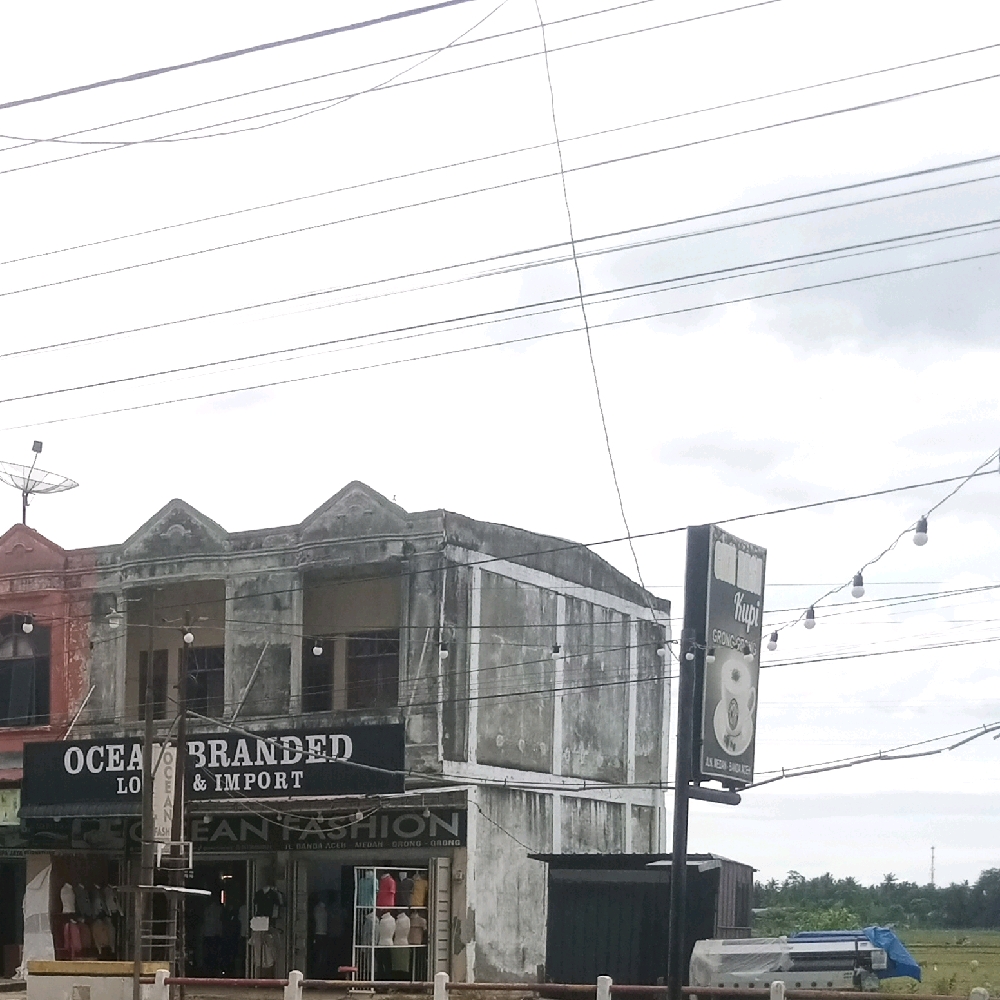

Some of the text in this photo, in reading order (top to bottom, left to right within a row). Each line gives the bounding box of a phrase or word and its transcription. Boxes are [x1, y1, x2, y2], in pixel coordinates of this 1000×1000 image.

[734, 592, 760, 633] Kupi
[186, 734, 353, 768] BRANDED
[192, 771, 303, 792] & IMPORT
[283, 811, 459, 841] FASHION
